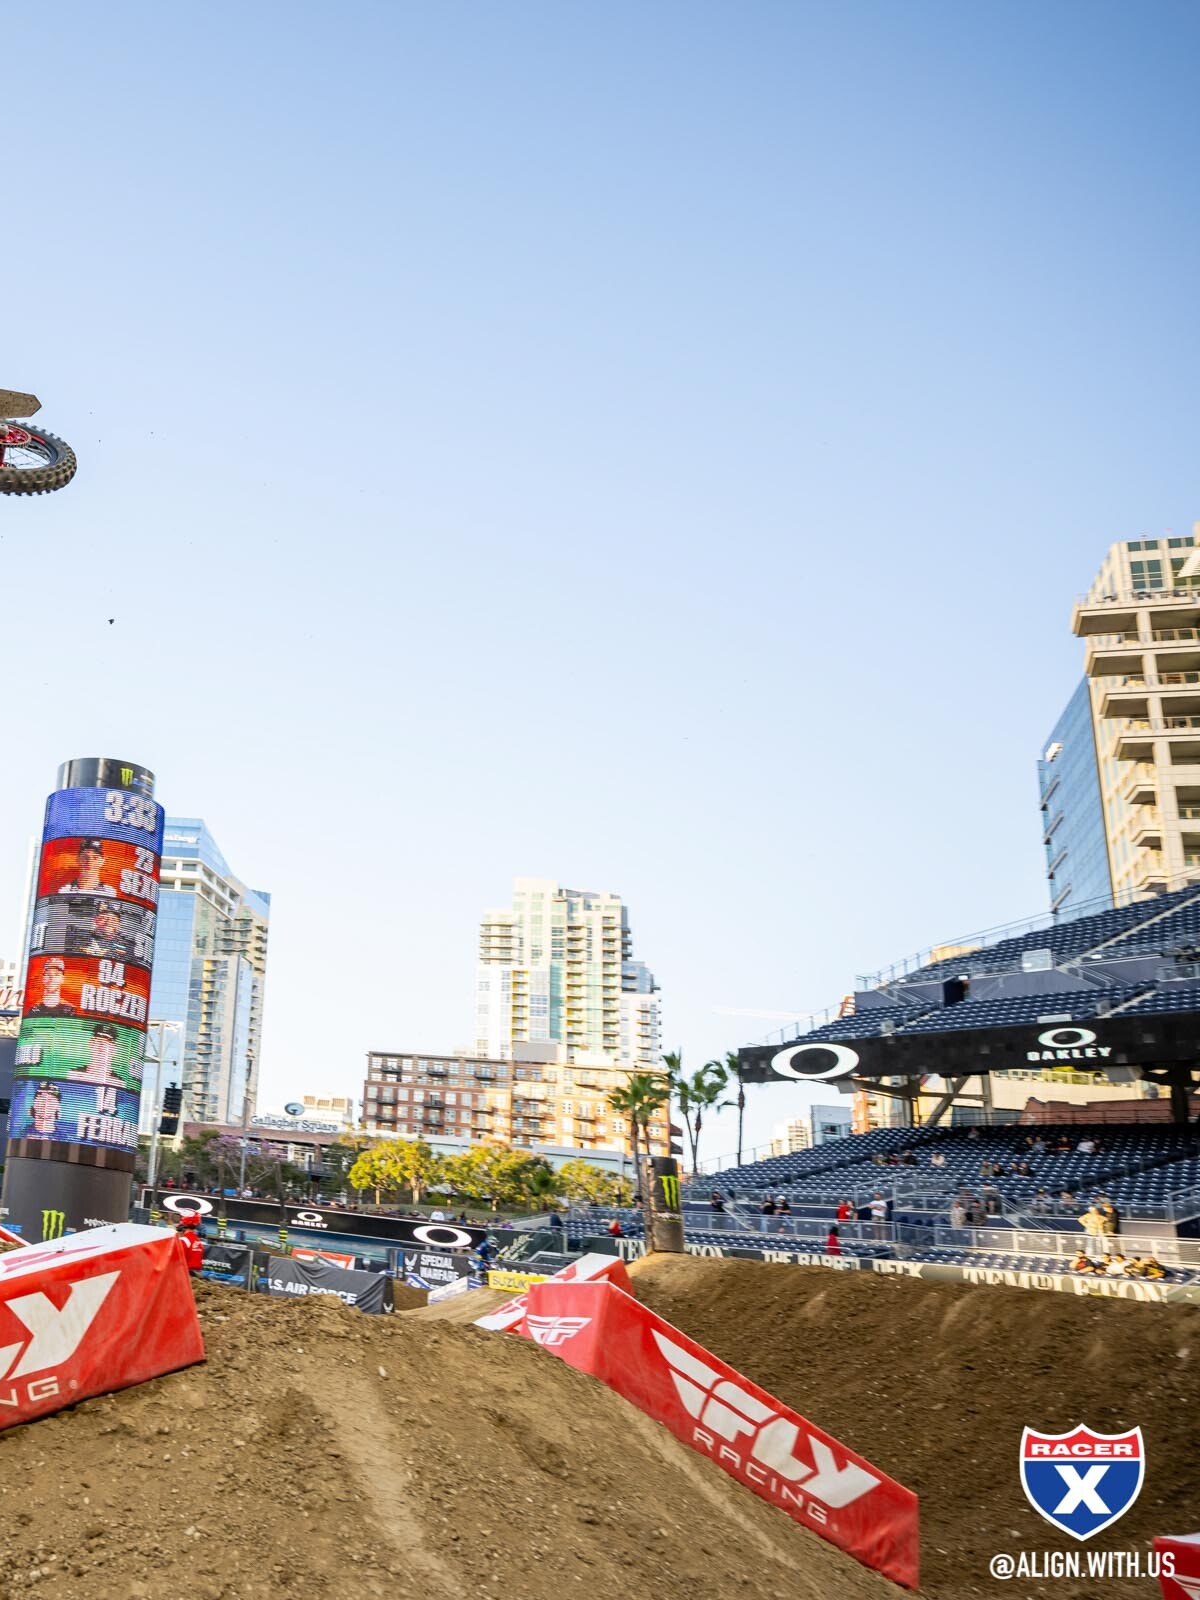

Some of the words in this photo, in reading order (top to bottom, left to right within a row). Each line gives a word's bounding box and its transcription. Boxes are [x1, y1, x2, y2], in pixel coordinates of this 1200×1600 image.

[1026, 1045, 1112, 1062] OAKLEY
[250, 1115, 299, 1130] Gallagher
[301, 1119, 338, 1133] Square
[290, 1219, 329, 1229] OAKLEY
[420, 1254, 455, 1269] SPECIAL
[420, 1265, 460, 1284] WARFARE
[492, 1275, 530, 1291] SUZUK
[285, 1282, 307, 1296] AIR
[962, 1268, 1171, 1304] TEMPLETON
[650, 1327, 882, 1509] FLY
[693, 1426, 828, 1526] RACING
